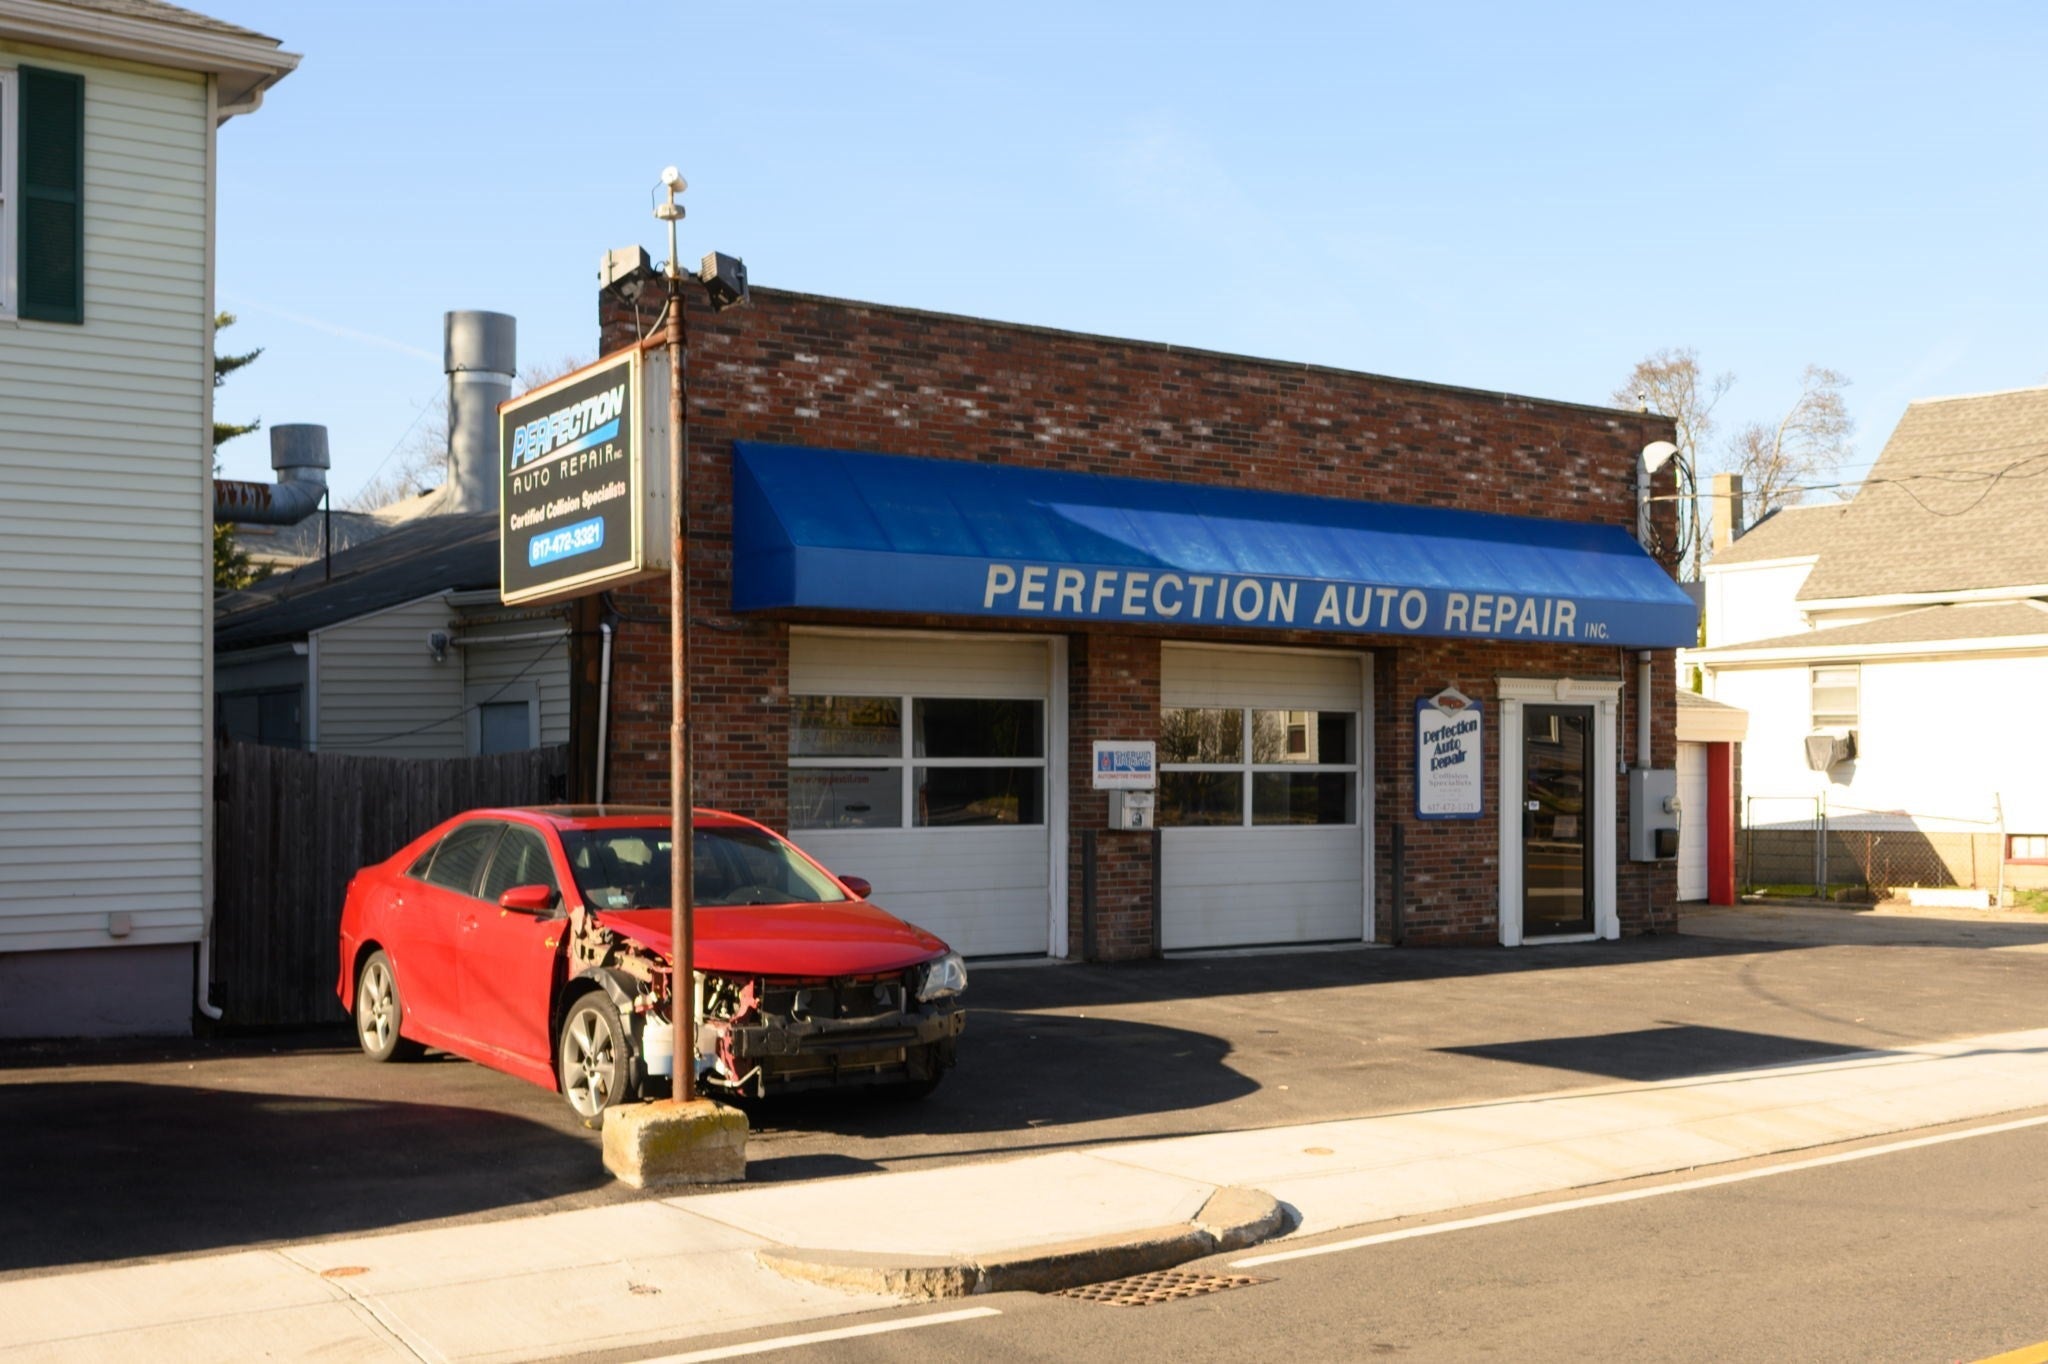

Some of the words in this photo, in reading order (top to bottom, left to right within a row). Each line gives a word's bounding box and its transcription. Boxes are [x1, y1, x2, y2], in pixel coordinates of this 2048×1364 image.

[511, 384, 625, 469] PERFECTION
[513, 467, 550, 495] AUTO
[560, 443, 613, 479] REPAIR
[510, 504, 545, 531] Certified
[546, 496, 580, 519] Collision
[582, 481, 626, 510] Specialists
[532, 522, 600, 560] 617-472-3321
[983, 564, 1299, 623] PERFECTION
[1314, 585, 1428, 629] AUTO
[1444, 594, 1577, 637] REPAIR
[1585, 622, 1610, 639] INC.
[1423, 719, 1477, 745] Perfection
[1434, 738, 1461, 757] Auto
[1115, 751, 1152, 760] SHERWIN
[1430, 750, 1467, 771] Repair
